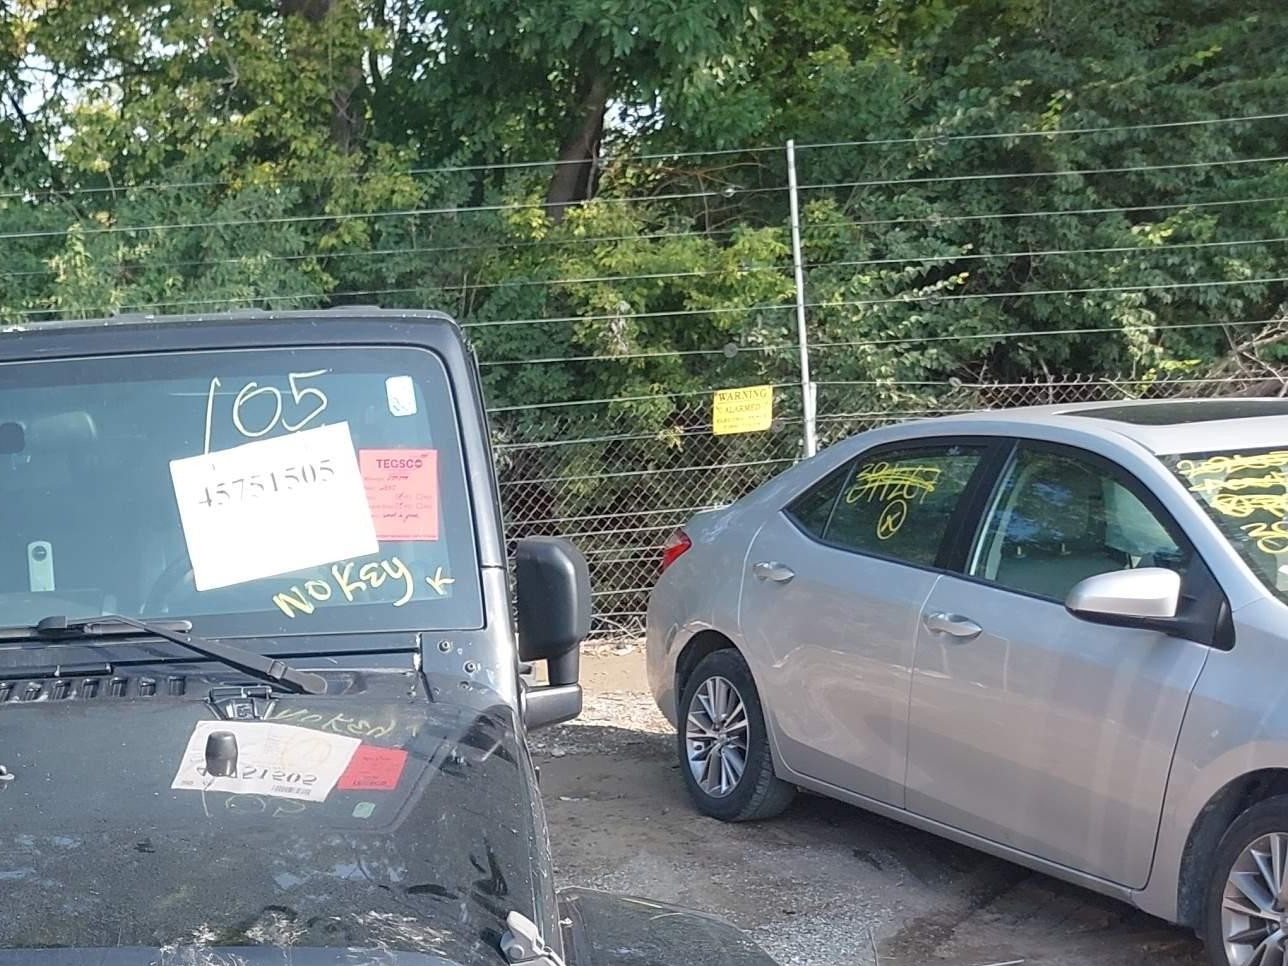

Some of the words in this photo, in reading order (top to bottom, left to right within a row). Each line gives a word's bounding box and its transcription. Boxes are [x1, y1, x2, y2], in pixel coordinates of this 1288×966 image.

[204, 368, 333, 454] 105
[718, 388, 767, 402] WARNING
[375, 459, 423, 469] TEGSCO
[198, 458, 336, 508] 45751505
